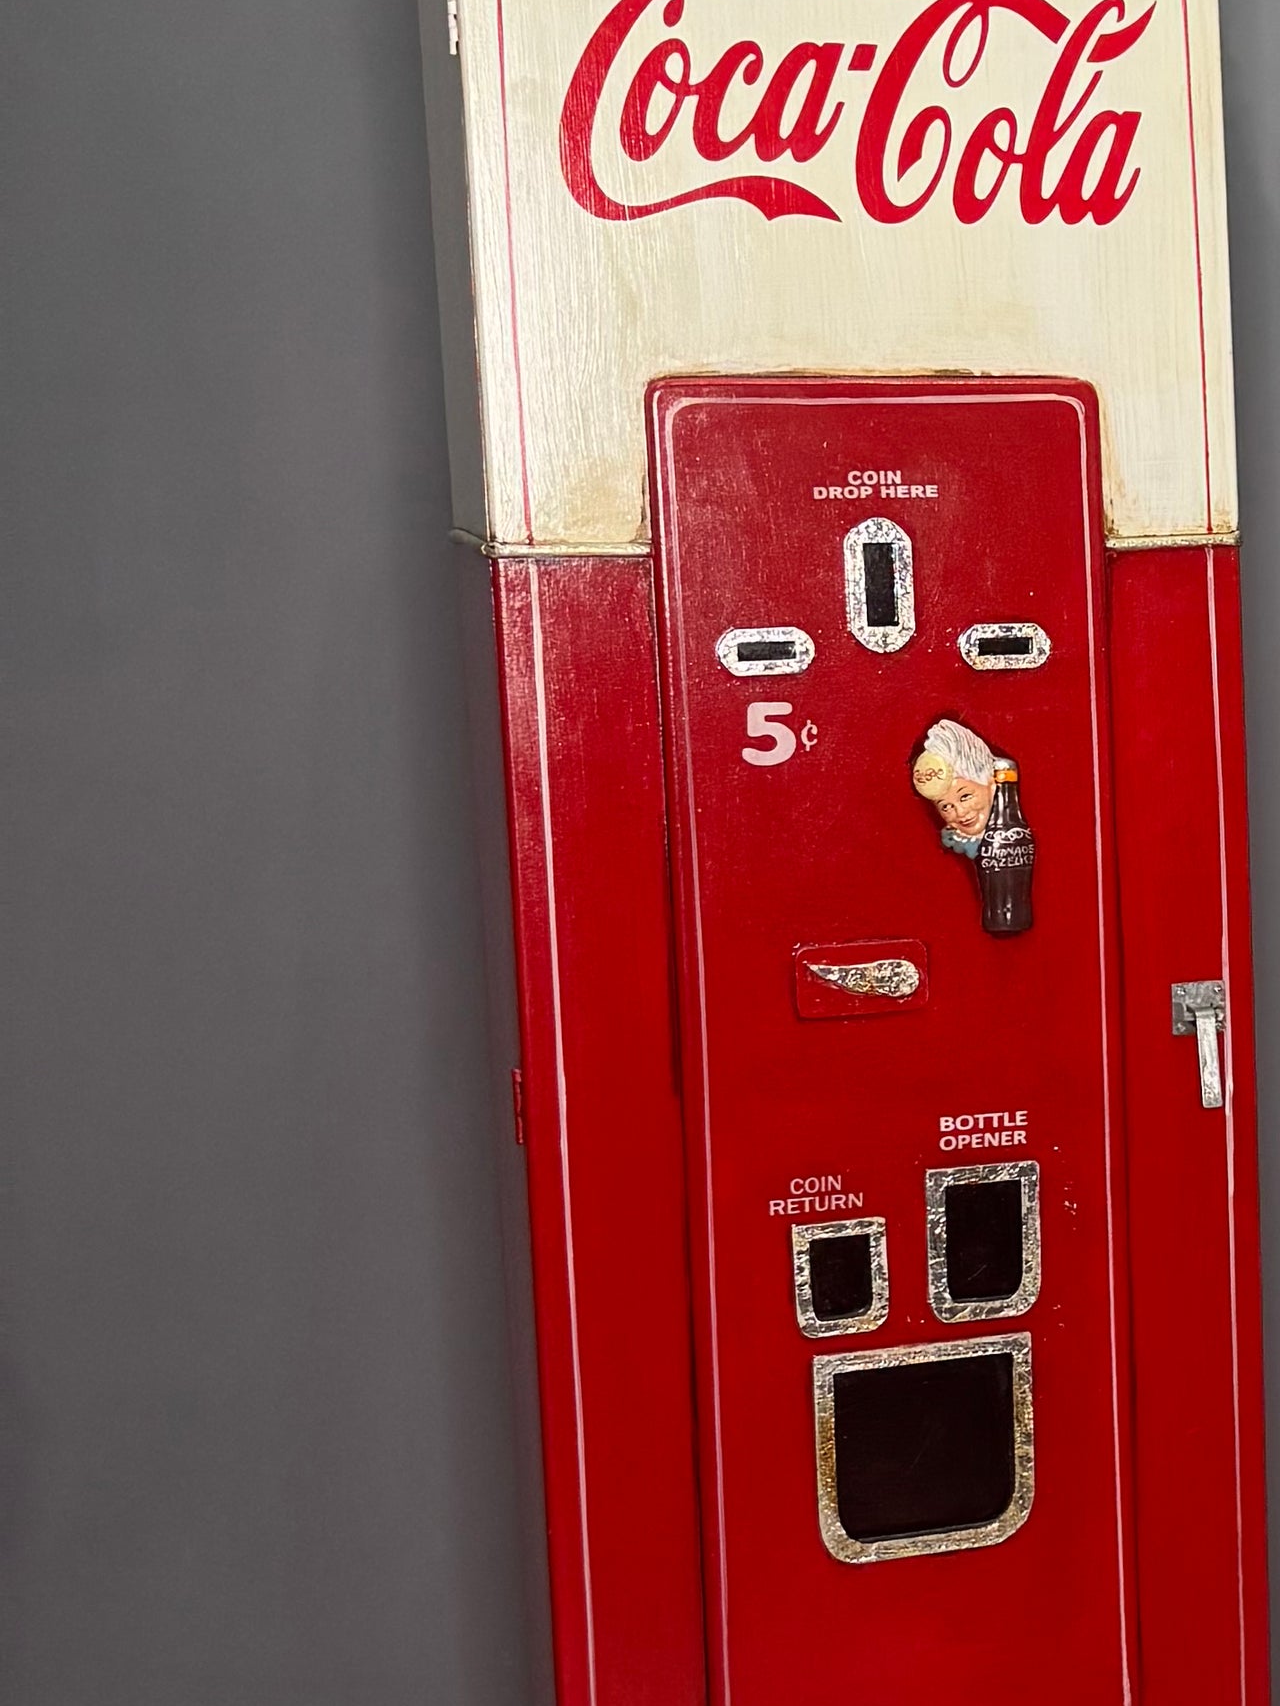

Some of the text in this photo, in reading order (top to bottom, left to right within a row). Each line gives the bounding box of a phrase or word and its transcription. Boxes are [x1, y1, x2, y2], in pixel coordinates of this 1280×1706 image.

[847, 470, 902, 485] COIN
[813, 483, 939, 500] DROP HERE
[939, 1110, 1029, 1132] BOTTLE
[938, 1130, 1028, 1151] OPENER
[789, 1175, 842, 1195] COIN
[768, 1192, 864, 1216] RETURN
